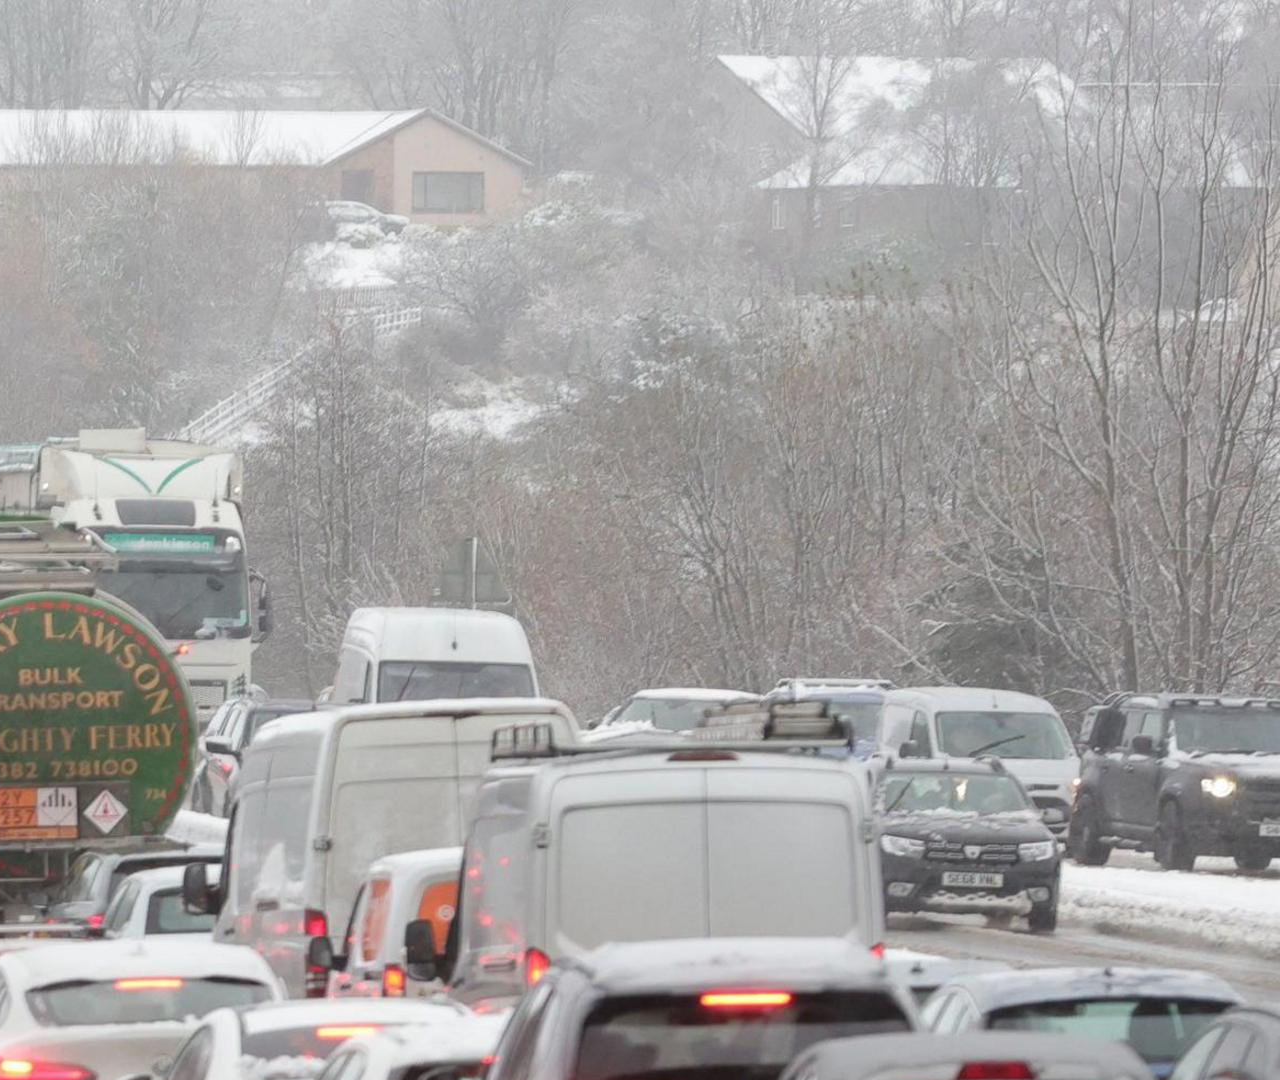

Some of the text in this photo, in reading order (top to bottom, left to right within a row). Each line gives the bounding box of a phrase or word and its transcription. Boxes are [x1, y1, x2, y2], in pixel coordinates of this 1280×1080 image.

[43, 612, 173, 716] LAWSON
[18, 667, 83, 686] BULK
[90, 723, 177, 750] FERRY
[50, 758, 139, 778] 738100
